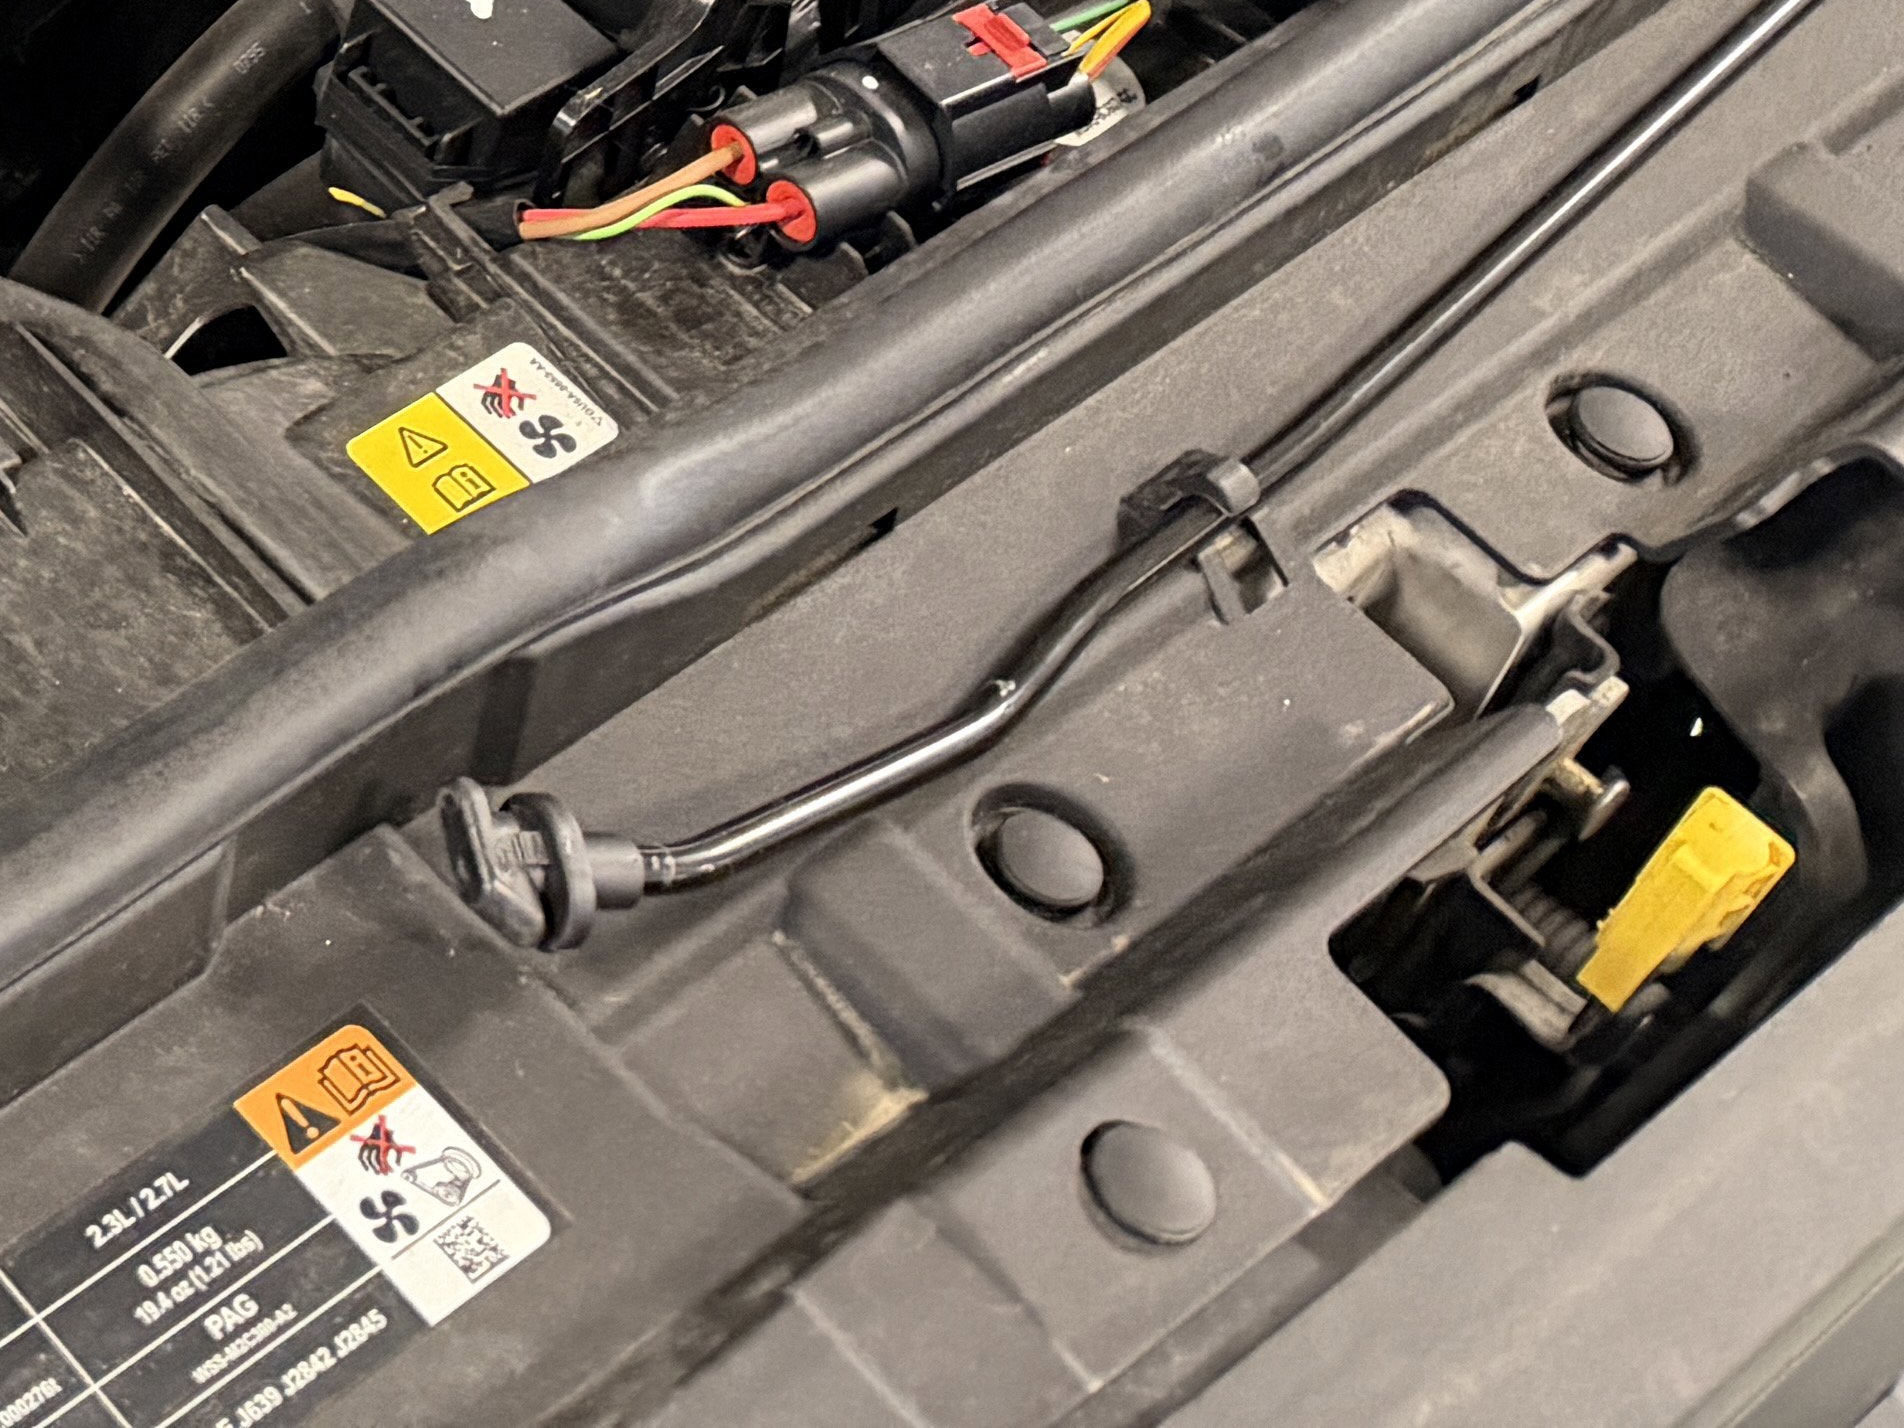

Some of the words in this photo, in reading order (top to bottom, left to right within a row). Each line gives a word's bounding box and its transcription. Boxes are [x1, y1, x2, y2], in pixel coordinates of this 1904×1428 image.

[84, 1208, 136, 1249] 2.3L
[139, 1171, 190, 1210] 2.7L
[134, 1291, 176, 1326] 19.4
[170, 1279, 196, 1304] oz
[187, 1253, 232, 1291] (1.21
[224, 1229, 265, 1260] lbs)
[137, 1239, 194, 1288] 0.550
[184, 1225, 223, 1255] kg
[202, 1292, 259, 1341] PAG
[234, 1385, 284, 1428] J639
[280, 1346, 338, 1397] J2842
[332, 1308, 388, 1359] J2845
